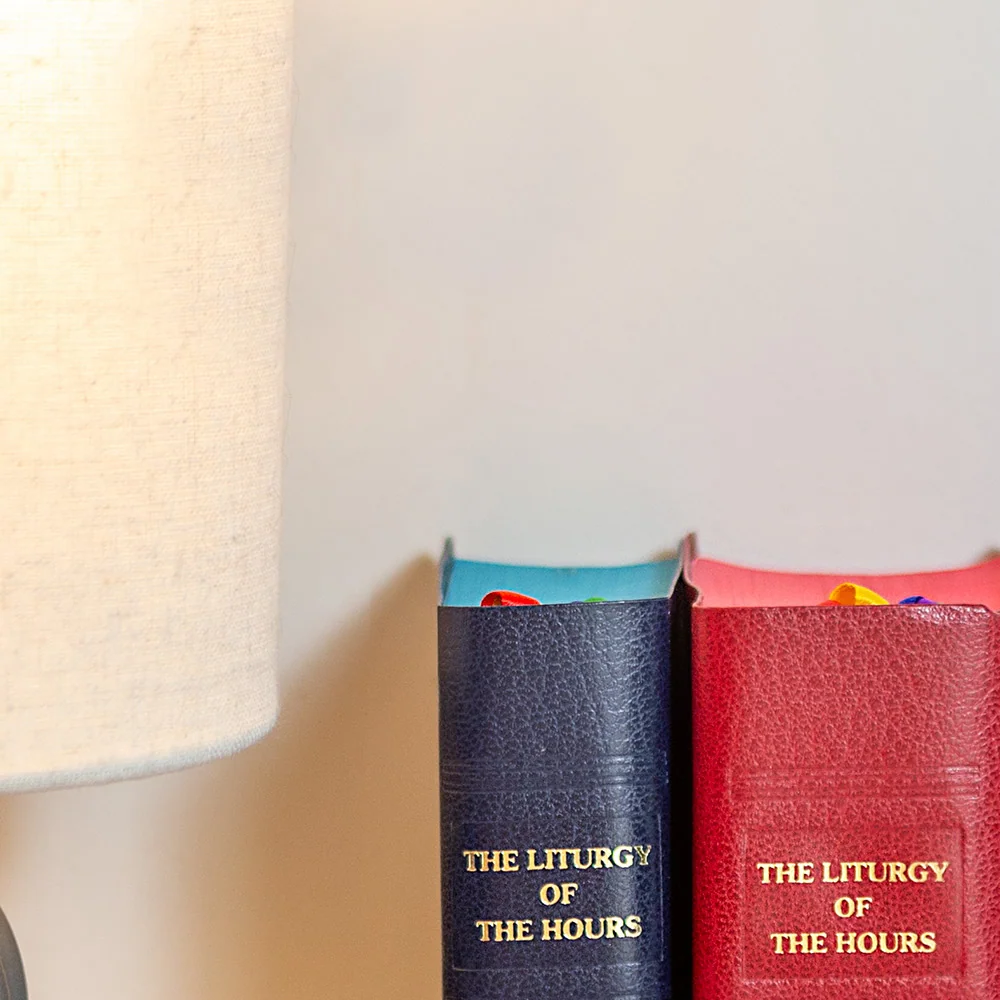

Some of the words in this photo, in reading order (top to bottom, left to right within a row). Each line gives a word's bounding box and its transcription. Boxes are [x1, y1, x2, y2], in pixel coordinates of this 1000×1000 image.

[463, 845, 520, 871] THE
[526, 845, 653, 872] LITURGY
[756, 861, 815, 885] THE
[821, 861, 950, 884] LITURGY
[539, 882, 579, 906] OF
[834, 896, 873, 918] OF
[475, 917, 534, 942] THE
[541, 914, 643, 940] HOURS
[769, 931, 828, 956] THE
[835, 931, 937, 956] HOURS
